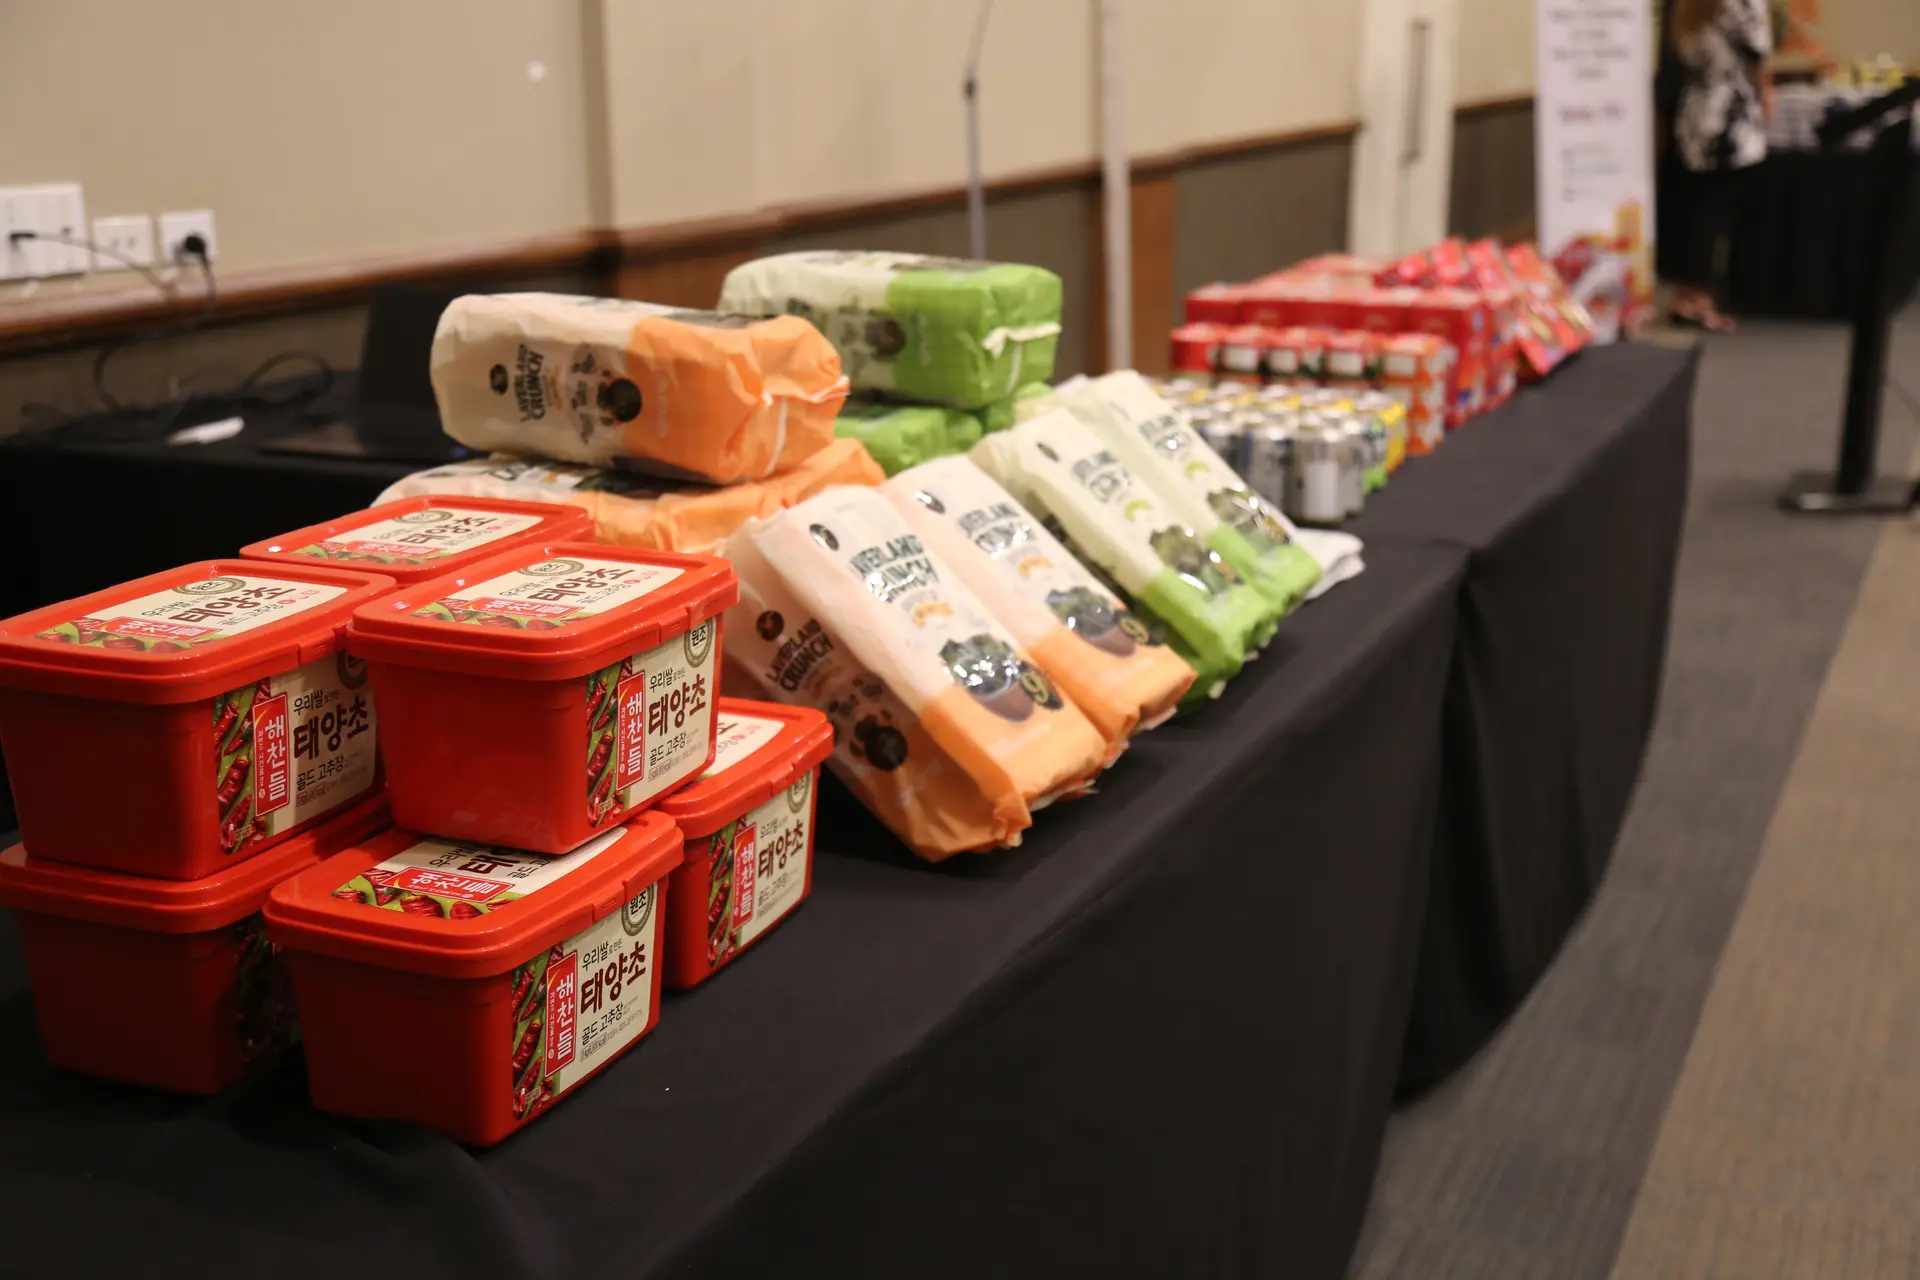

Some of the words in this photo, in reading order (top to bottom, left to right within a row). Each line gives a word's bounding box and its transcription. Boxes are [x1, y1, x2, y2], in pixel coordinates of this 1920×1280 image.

[526, 350, 547, 421] CRUNCH
[397, 516, 498, 544] 태양초
[168, 586, 297, 623] 태양초
[484, 599, 571, 615] 해찬들
[526, 568, 636, 602] 태양초
[119, 620, 209, 637] 해찬들
[691, 625, 706, 647] 원조
[780, 632, 834, 692] CRUNCH
[293, 694, 369, 761] 태양초
[648, 673, 706, 737] 태양초
[626, 691, 643, 777] 해찬들
[649, 744, 665, 767] 골드
[665, 731, 687, 756] 고추장
[264, 714, 286, 802] 해찬들
[296, 771, 318, 792] 골드
[317, 754, 344, 781] 고추장
[757, 818, 804, 879] 태양초
[411, 871, 502, 895] 해찬들
[740, 841, 755, 918] 해찬들
[630, 890, 647, 916] 원조
[580, 940, 647, 1015] 태양초
[556, 972, 574, 1061] 해찬들
[581, 1022, 599, 1047] 골드
[599, 1001, 624, 1032] 고추장
